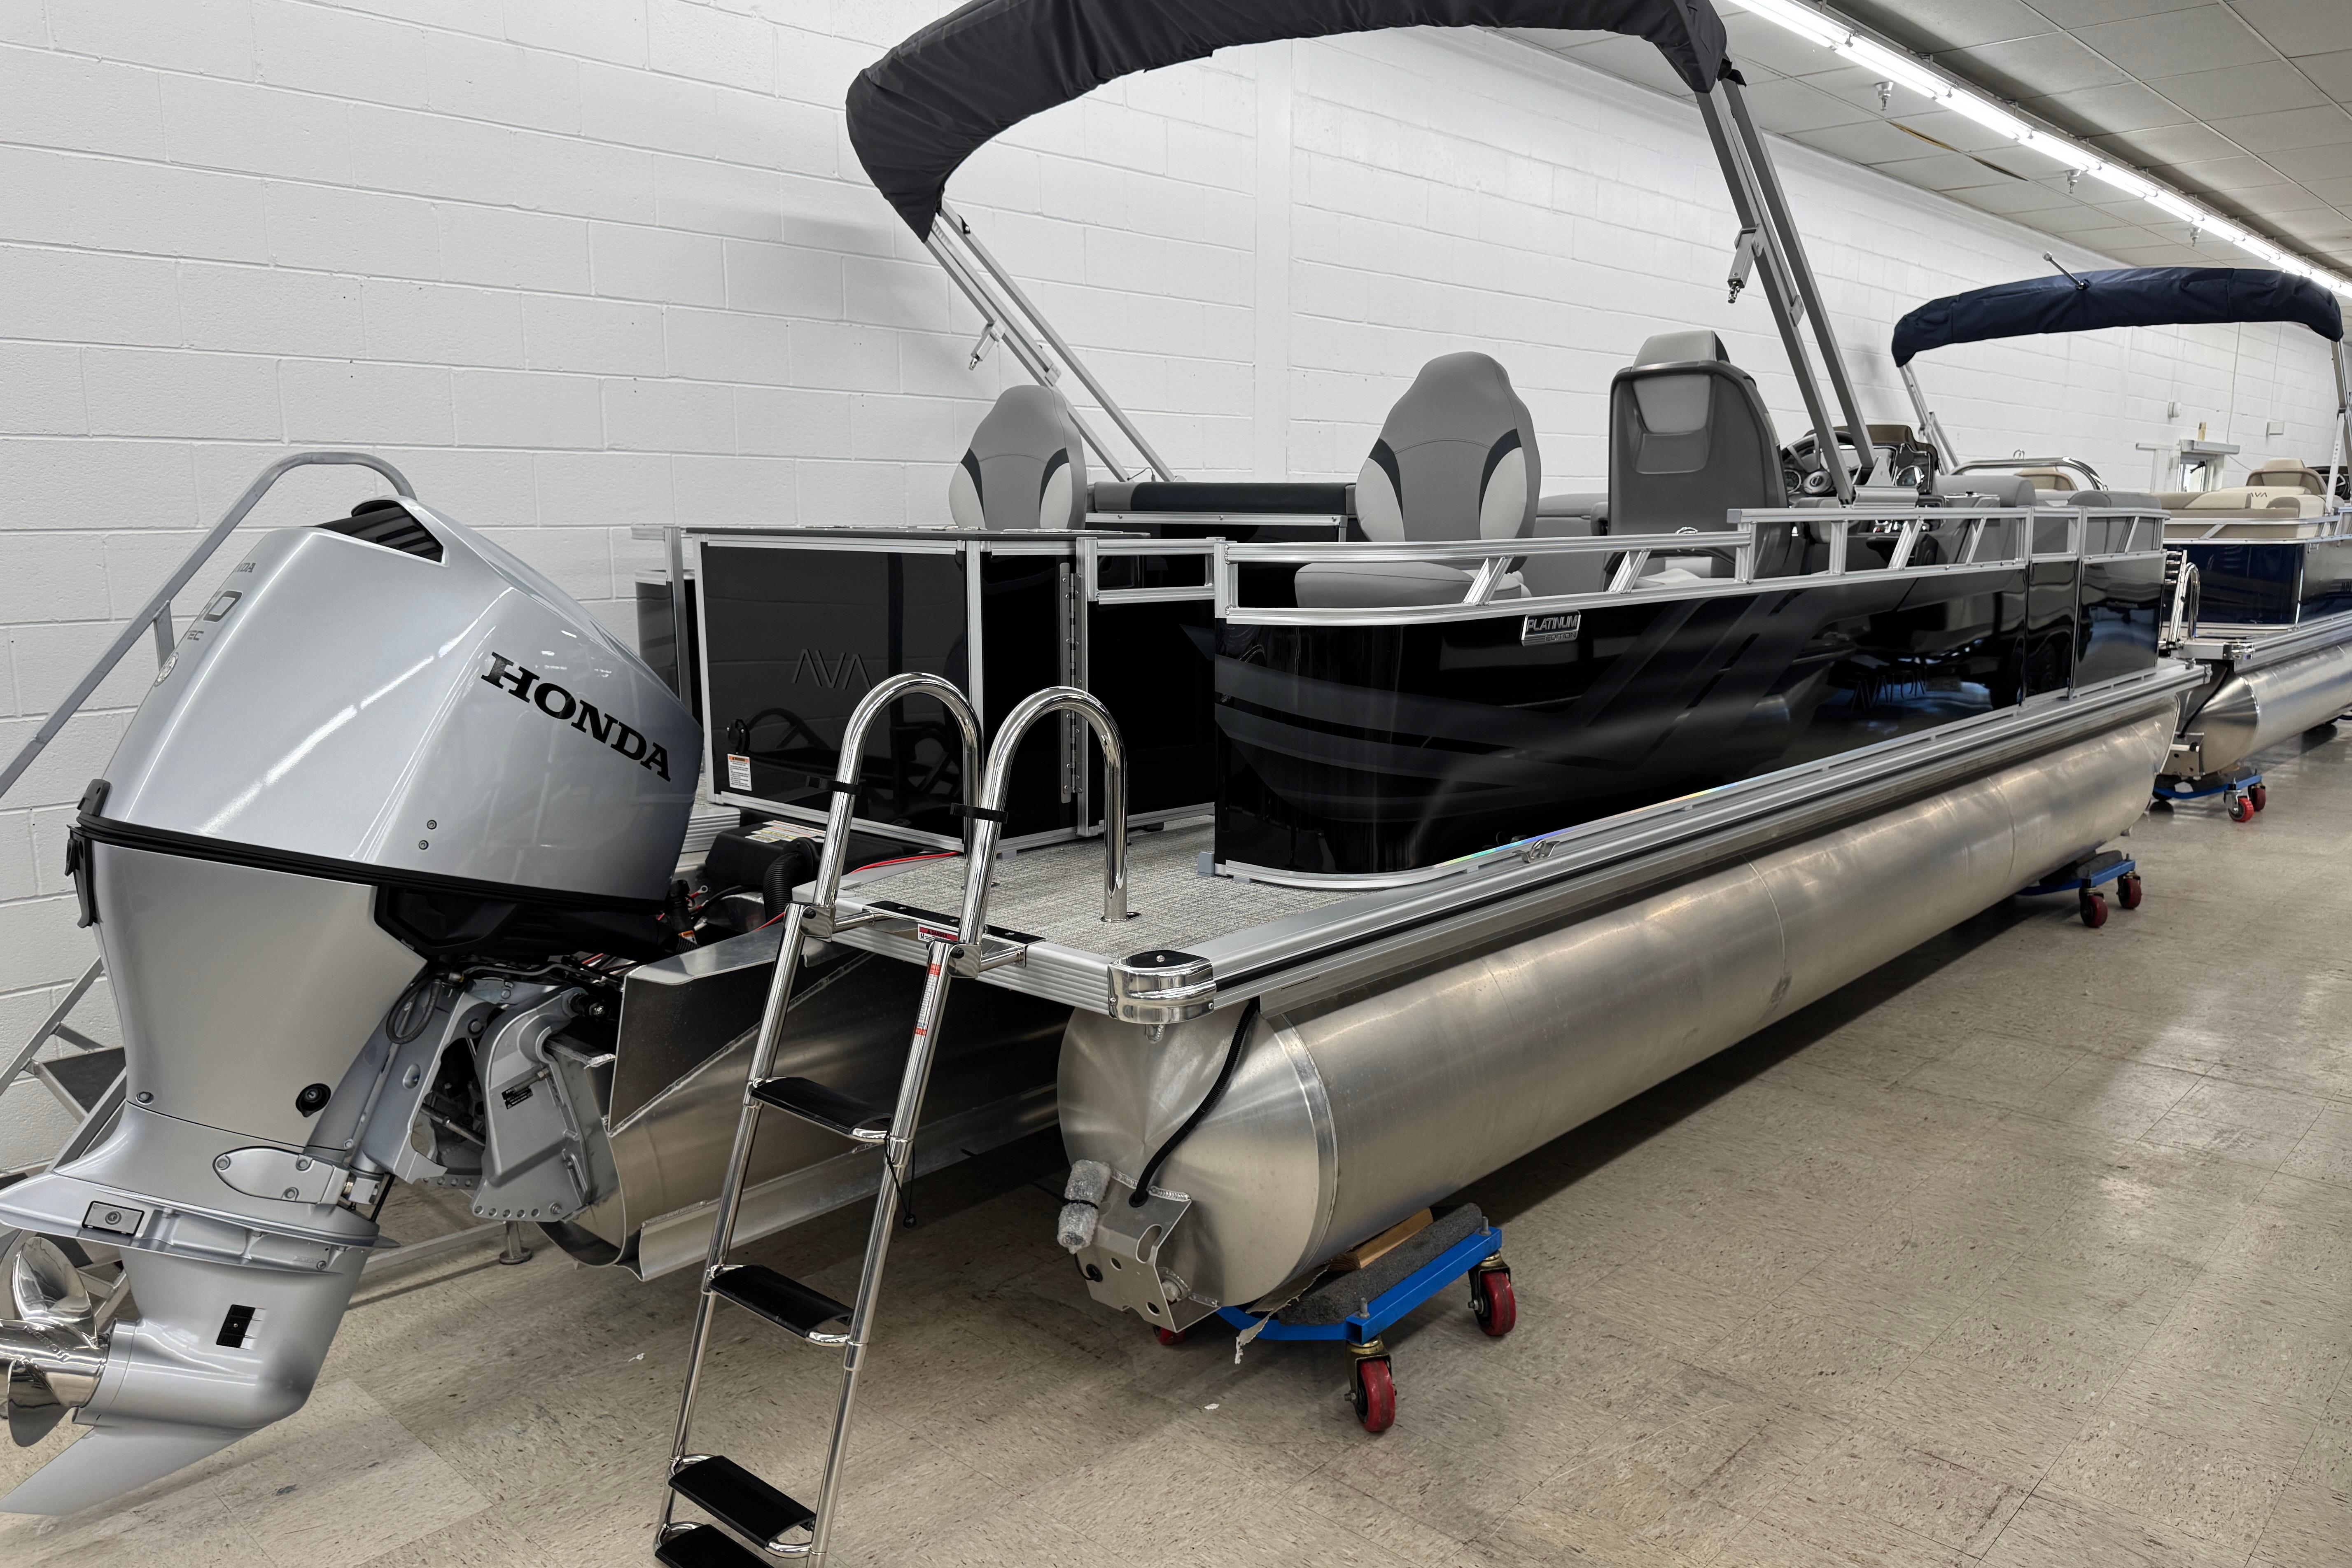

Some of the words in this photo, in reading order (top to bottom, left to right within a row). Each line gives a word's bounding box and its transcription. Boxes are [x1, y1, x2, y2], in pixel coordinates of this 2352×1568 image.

[1526, 615, 1577, 632] PLATINUM
[1545, 632, 1576, 642] EDITION
[792, 649, 873, 691] AVA
[481, 652, 671, 782] HONDA
